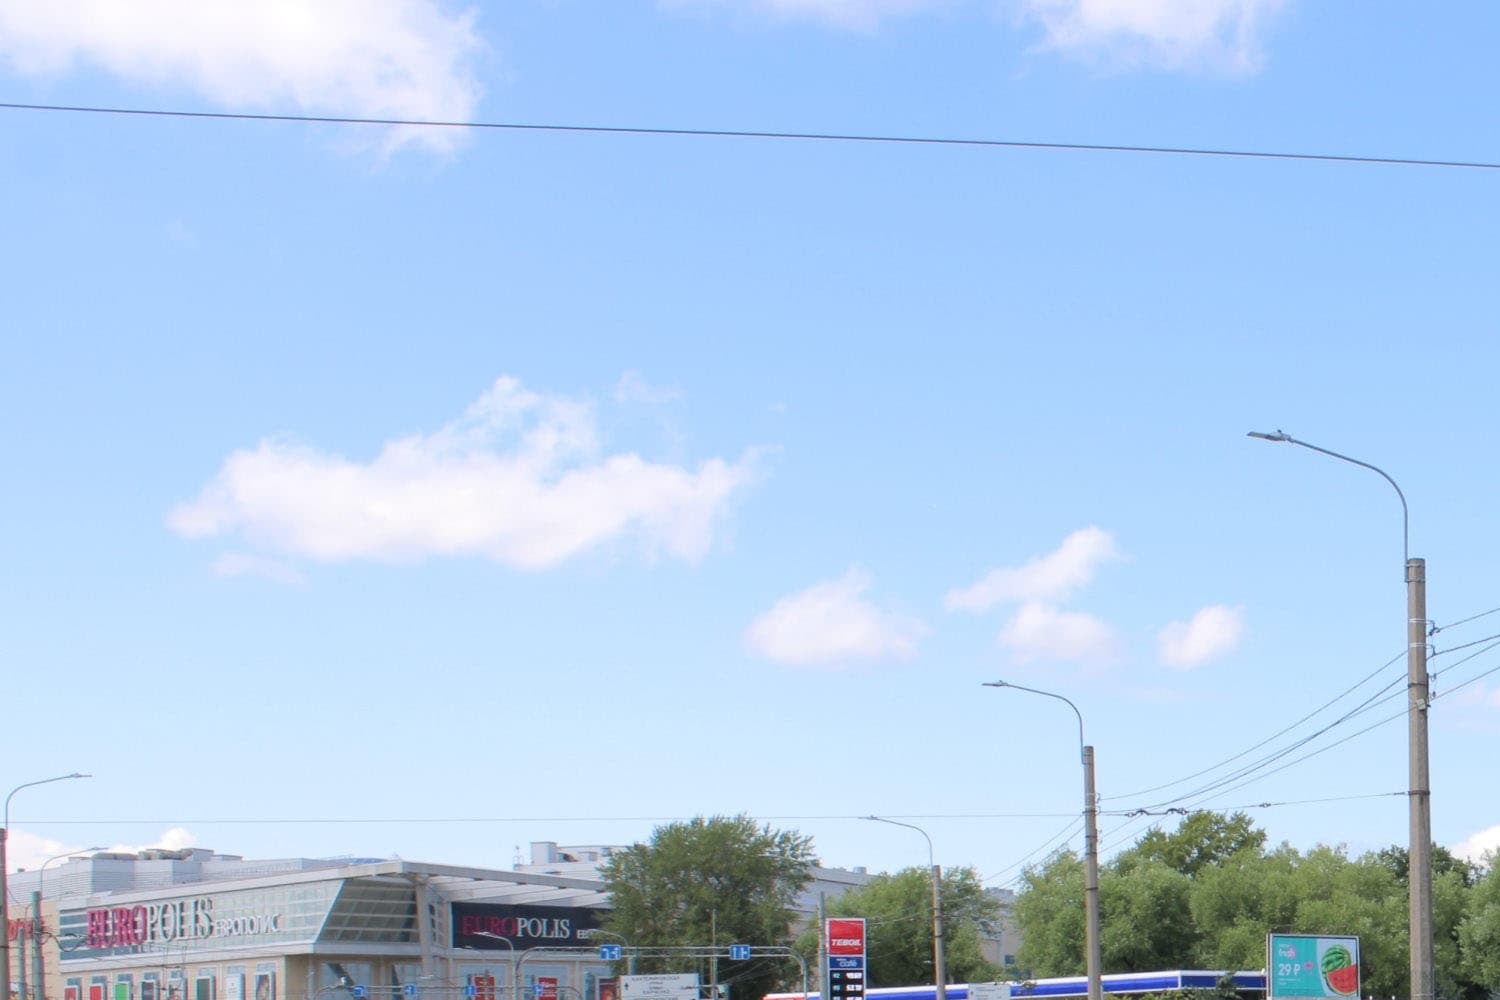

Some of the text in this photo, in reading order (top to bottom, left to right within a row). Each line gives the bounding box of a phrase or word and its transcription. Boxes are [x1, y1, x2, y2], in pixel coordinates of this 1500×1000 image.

[86, 897, 213, 948] EUROPOLIS
[214, 914, 281, 937] ЕВРОПОЛИС
[462, 915, 570, 939] EUROPOLIS
[831, 939, 862, 947] TEBOIL
